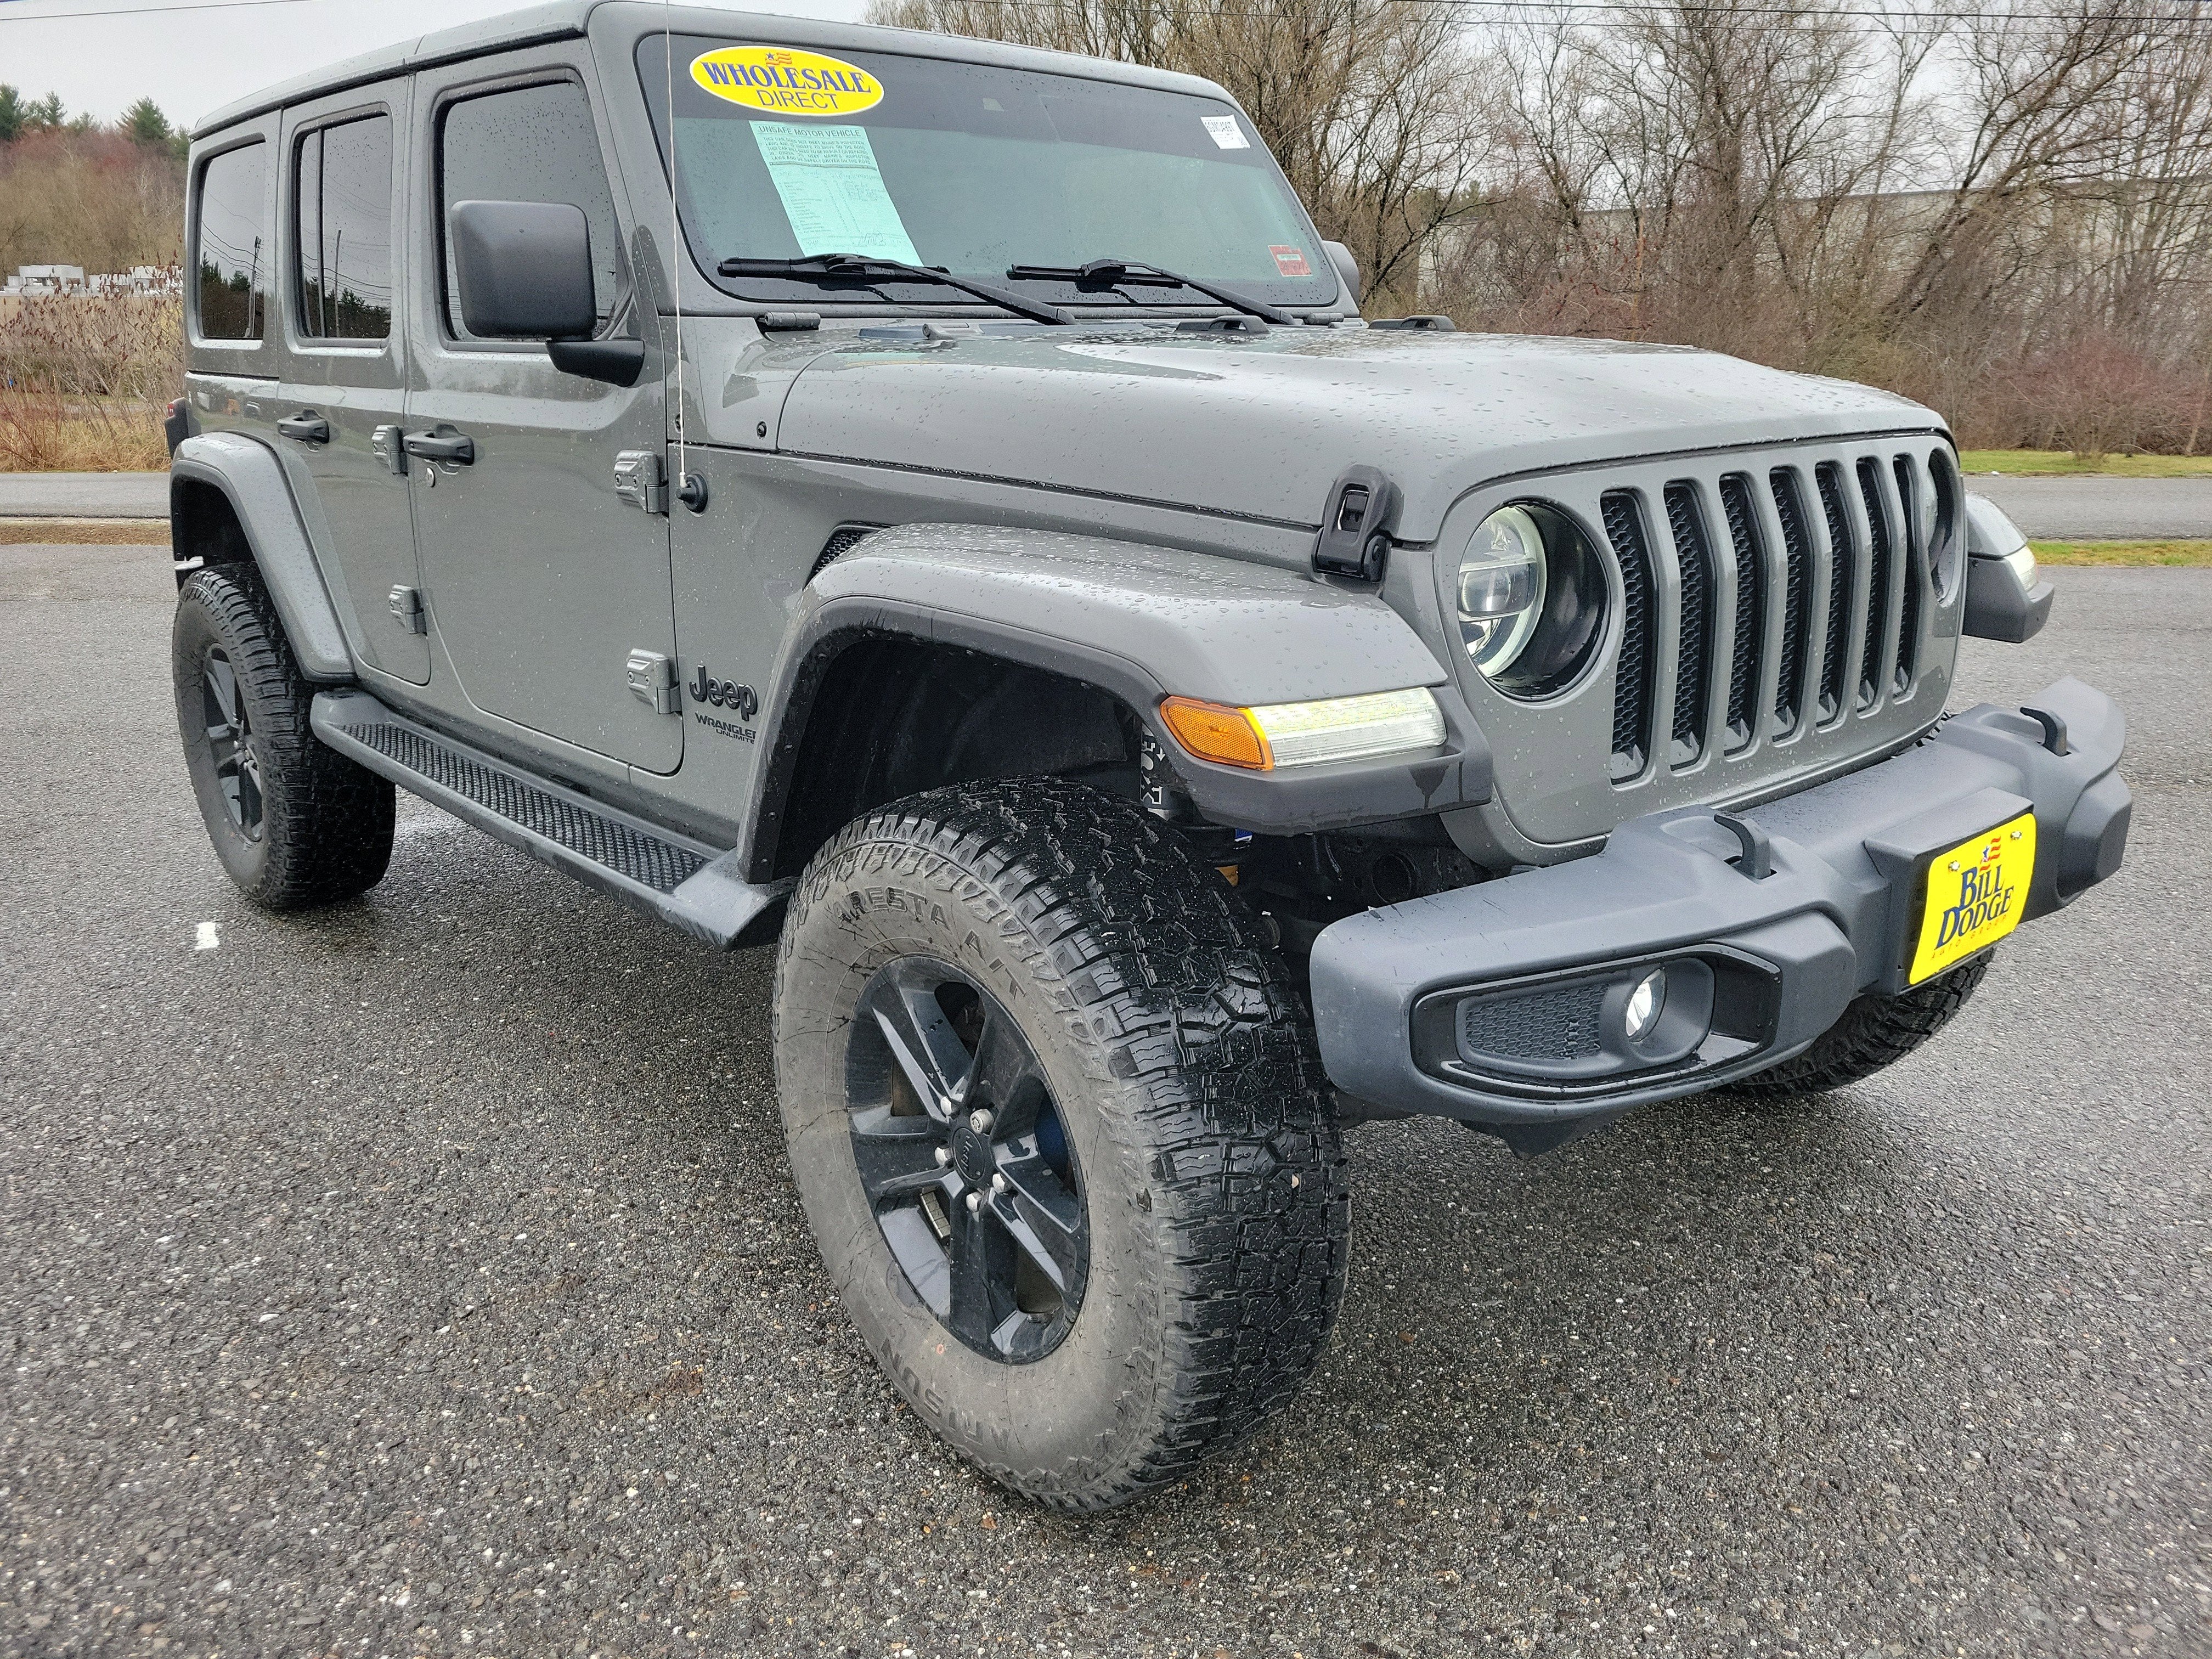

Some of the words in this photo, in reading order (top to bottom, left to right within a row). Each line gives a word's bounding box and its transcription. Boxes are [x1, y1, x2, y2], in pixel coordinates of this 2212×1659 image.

[699, 61, 872, 94] WHOLESALE
[756, 89, 839, 109] DIRECT
[759, 125, 793, 134] UNSAFE
[794, 128, 824, 137] MOTOR
[689, 664, 758, 721] Jeep
[715, 728, 755, 744] UNLIMITE
[1959, 864, 2005, 912] BILL
[1934, 885, 2015, 950] DODGE
